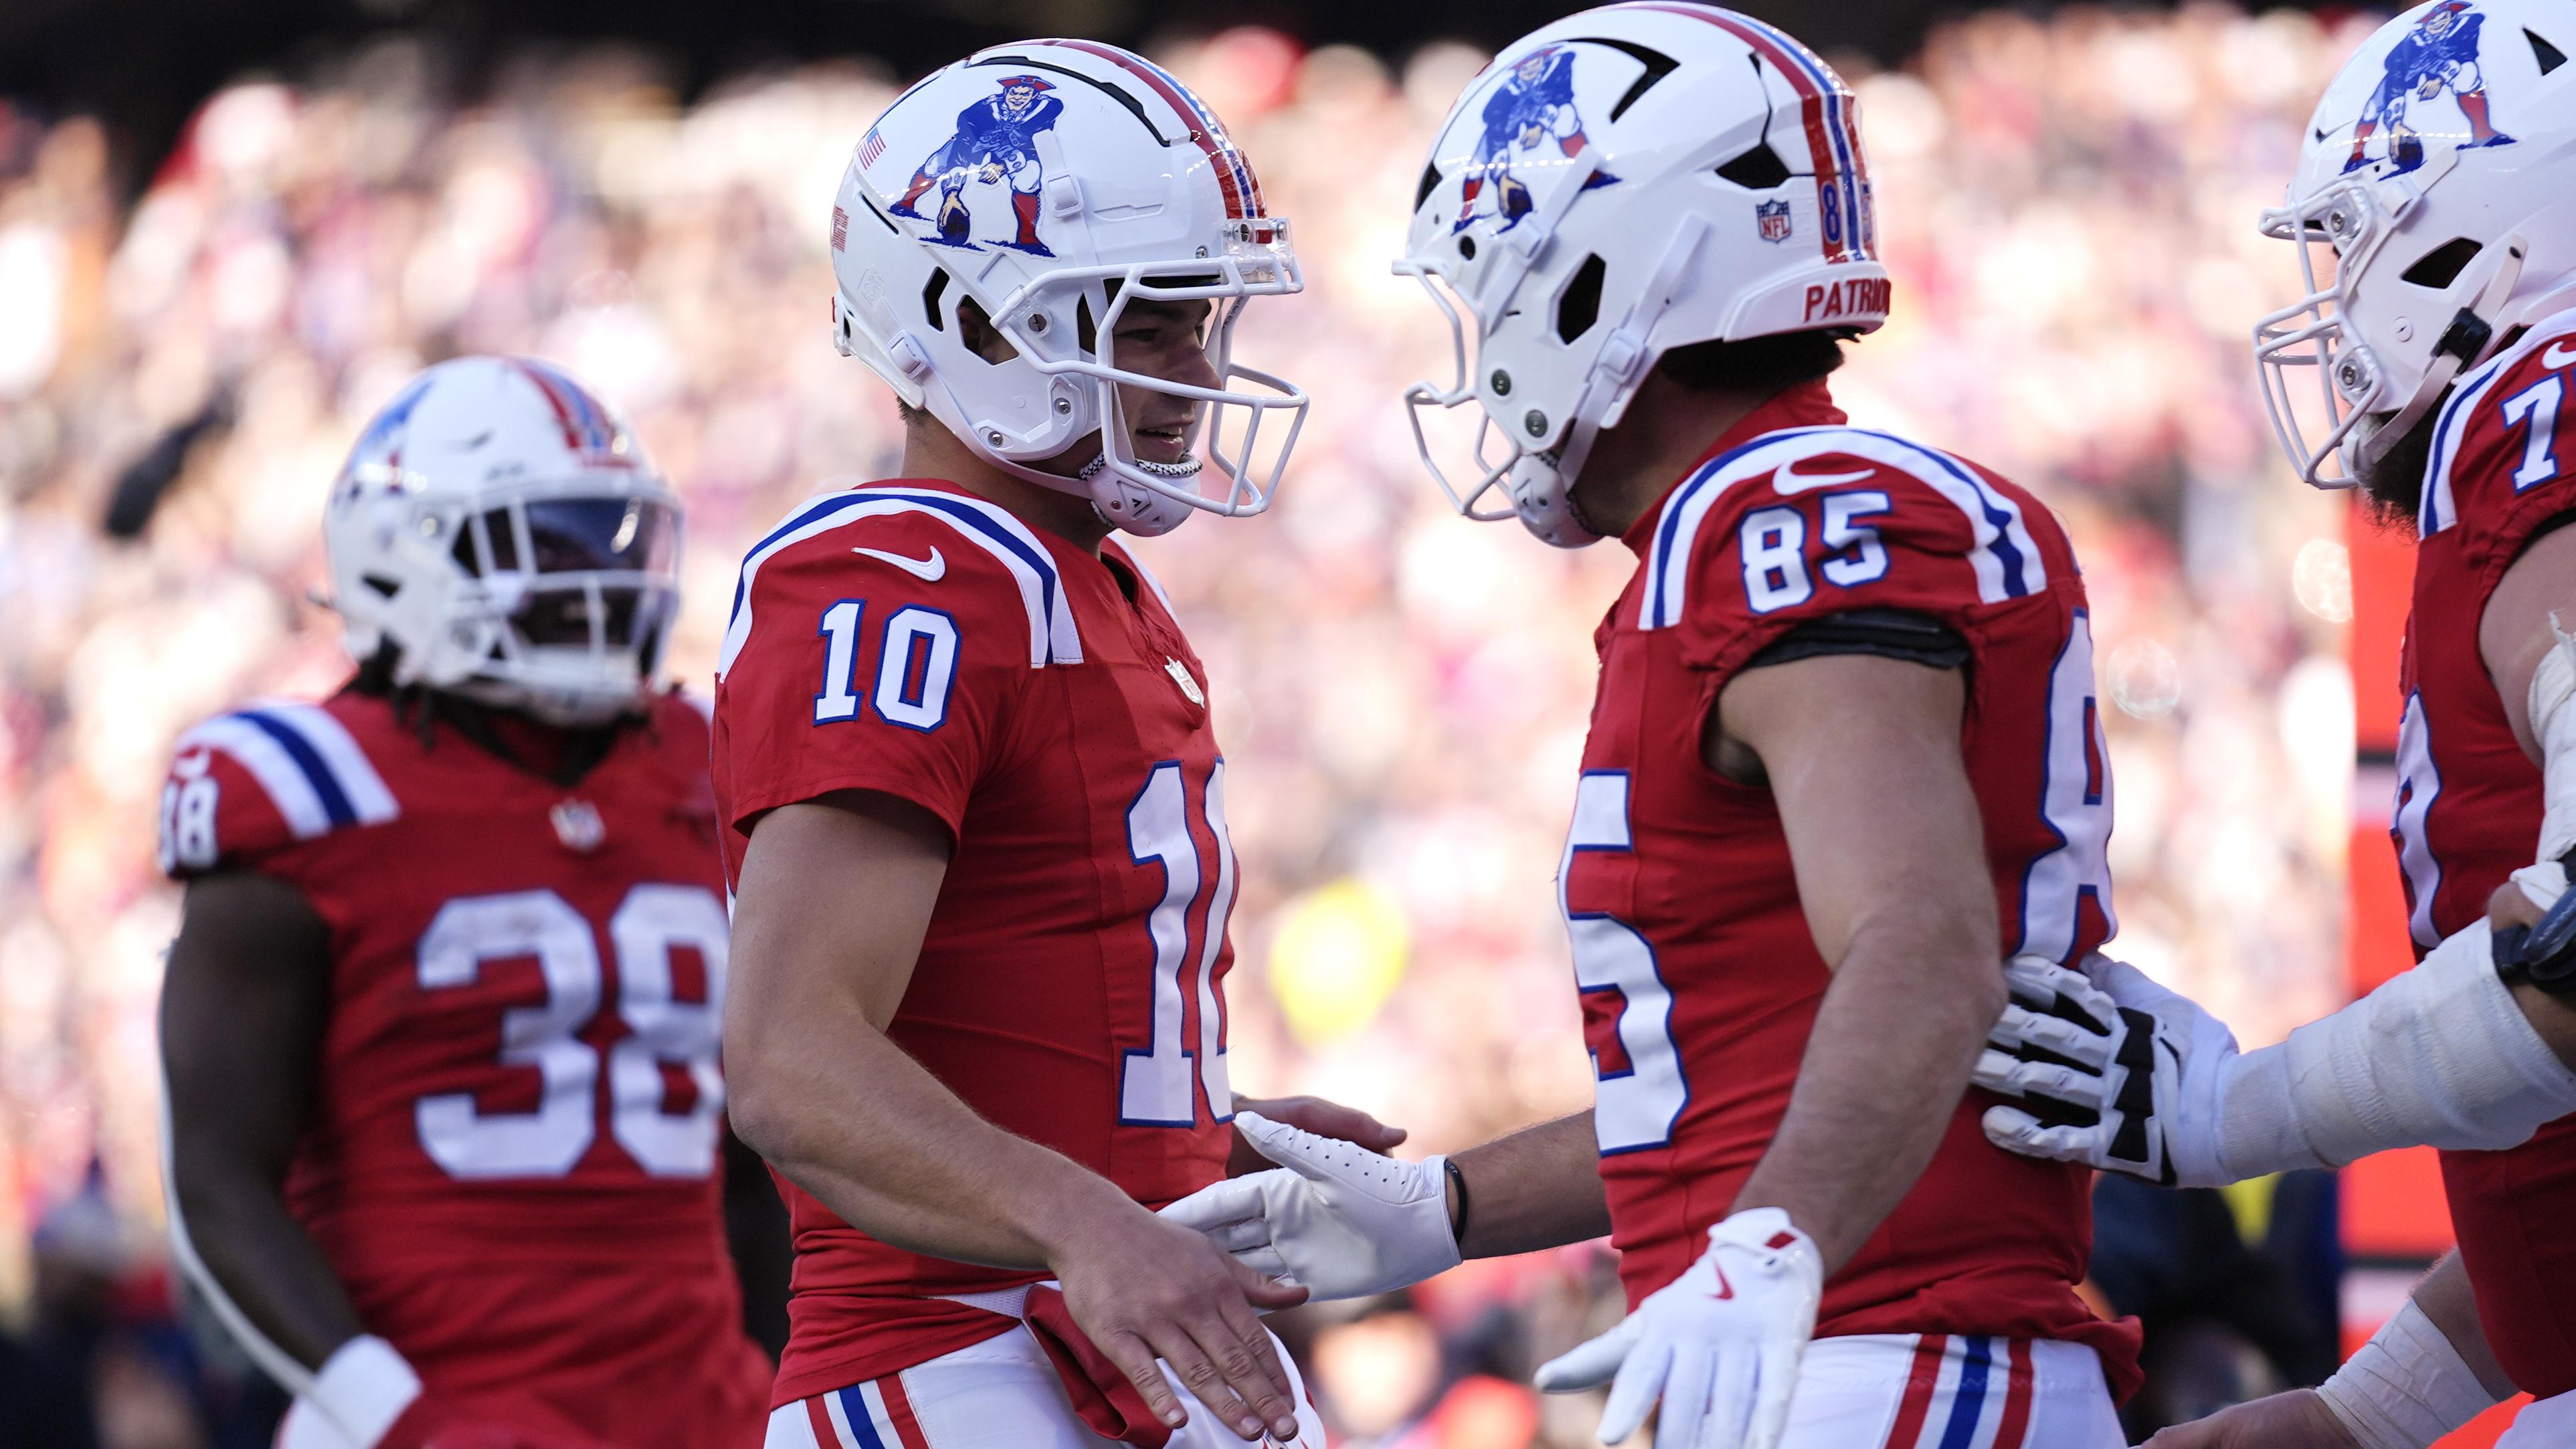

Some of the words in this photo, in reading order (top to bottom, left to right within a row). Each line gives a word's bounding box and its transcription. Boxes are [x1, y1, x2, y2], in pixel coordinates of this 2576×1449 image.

[1761, 217, 1791, 237] NFL
[1738, 490, 1892, 615] 85
[813, 598, 962, 734] 10
[415, 882, 731, 1183] 38
